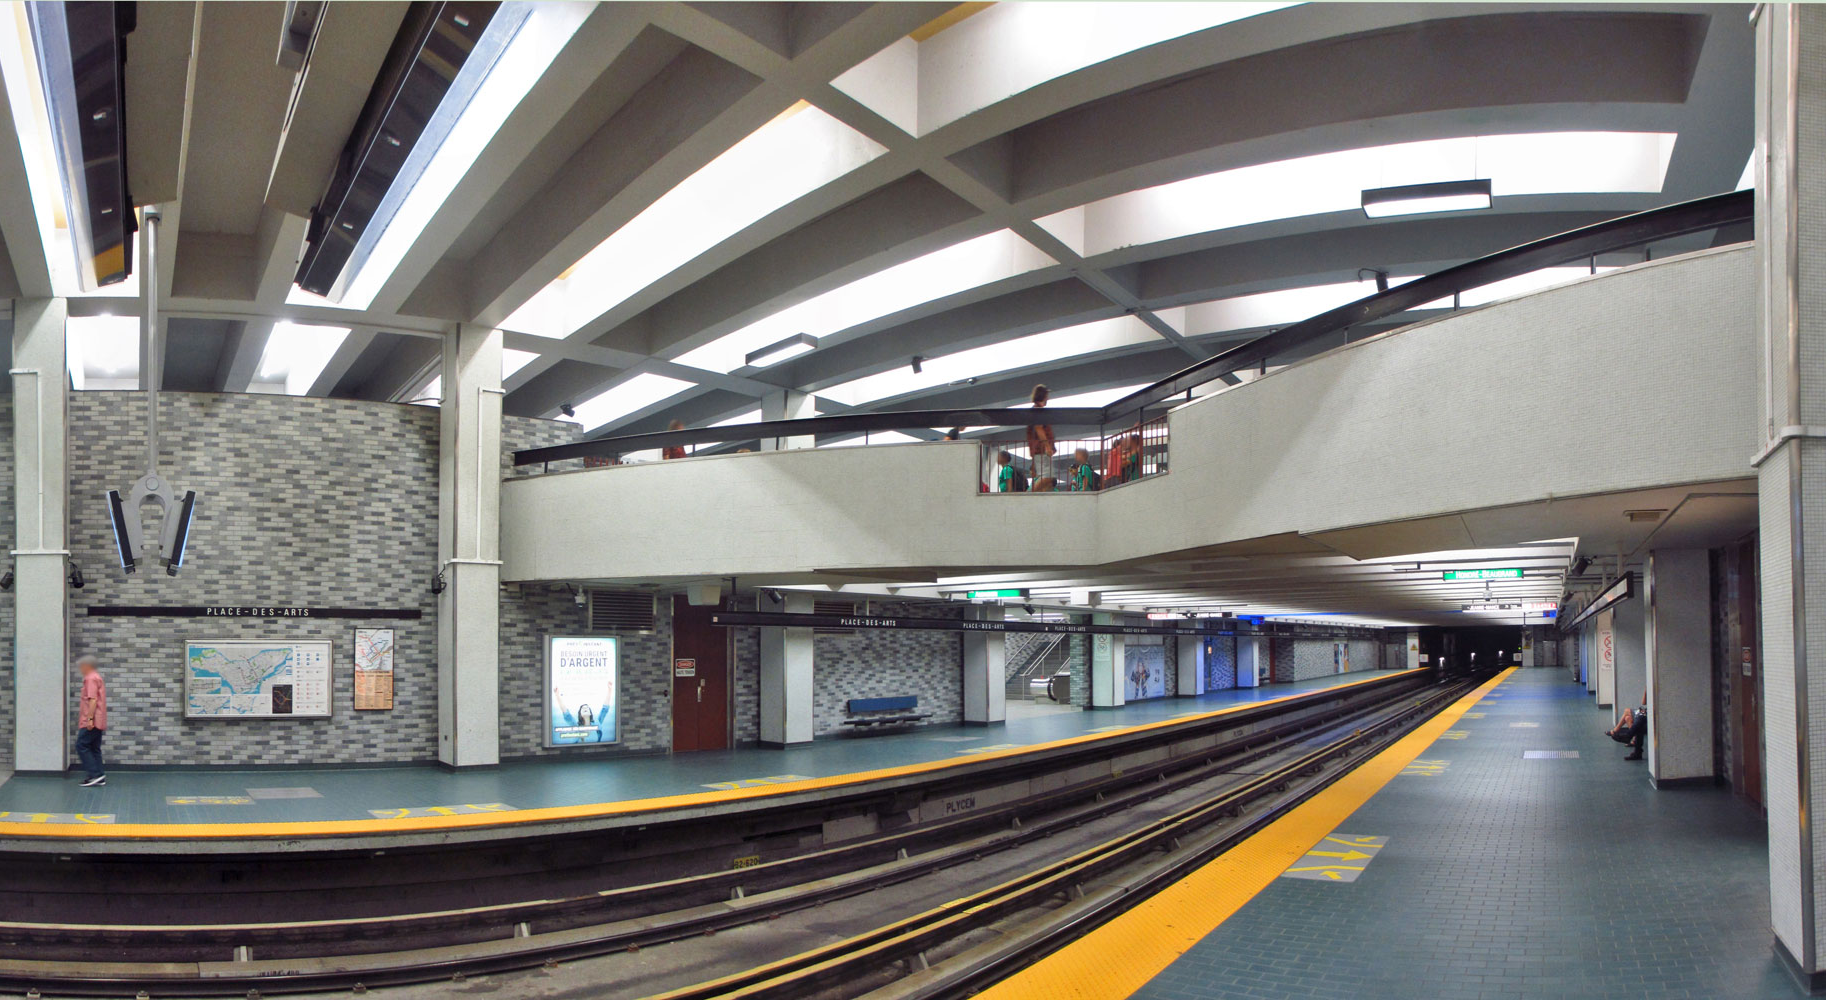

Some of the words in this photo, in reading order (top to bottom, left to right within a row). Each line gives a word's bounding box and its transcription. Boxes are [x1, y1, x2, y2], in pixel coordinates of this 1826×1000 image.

[207, 607, 310, 617] PLACE-DES-ARTS
[841, 618, 896, 627] PLACE-DES-ARTS
[963, 622, 1005, 630] PLACE-DES-ARTS
[560, 657, 608, 668] D'ARGENT
[946, 797, 975, 812] PLYCEM
